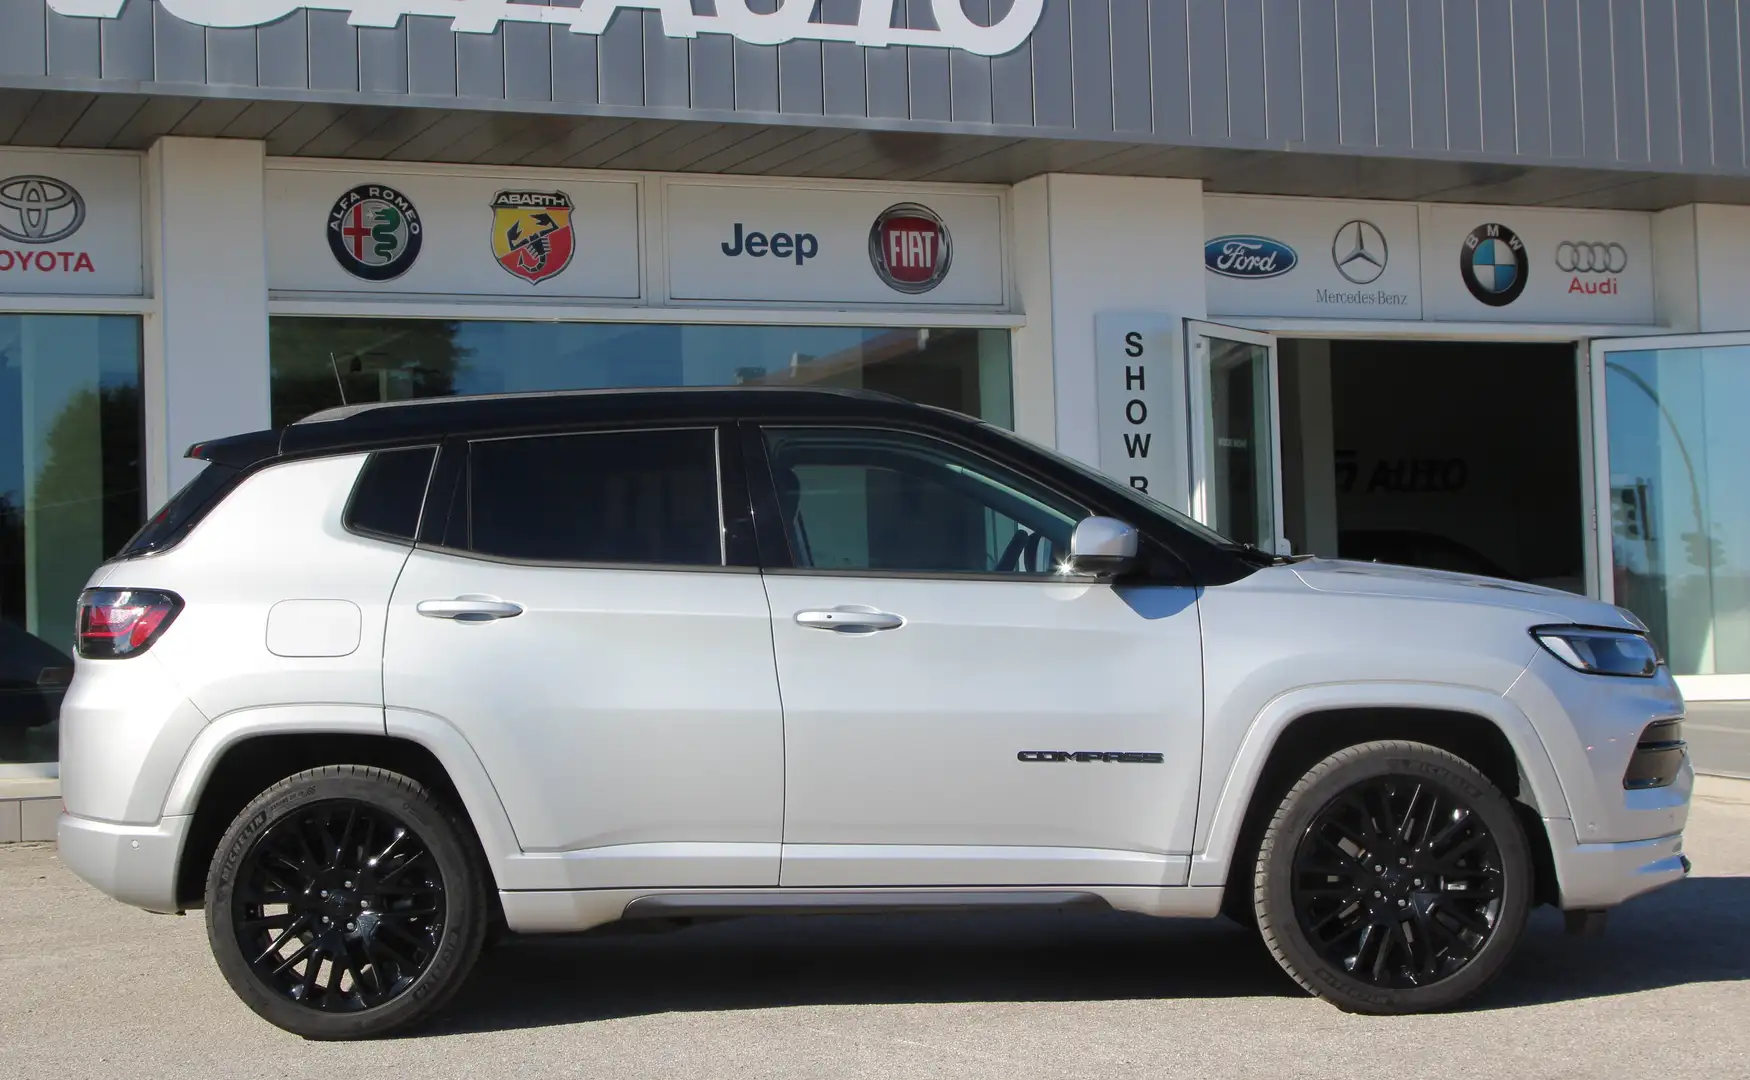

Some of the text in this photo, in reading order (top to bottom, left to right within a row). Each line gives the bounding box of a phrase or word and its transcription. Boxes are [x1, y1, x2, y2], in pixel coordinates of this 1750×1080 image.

[329, 187, 420, 235] ALFA ROMEO
[497, 194, 565, 206] ABARTH
[721, 222, 819, 266] Jeep
[888, 230, 935, 269] FIAT
[1465, 224, 1523, 251] BMW
[1216, 241, 1278, 272] Ford
[1316, 289, 1408, 306] Mercedes-Benz
[1567, 277, 1618, 295] Audi
[1123, 331, 1151, 459] SHOW
[1017, 750, 1165, 764] COMPASS
[221, 812, 266, 882] MICHELIN
